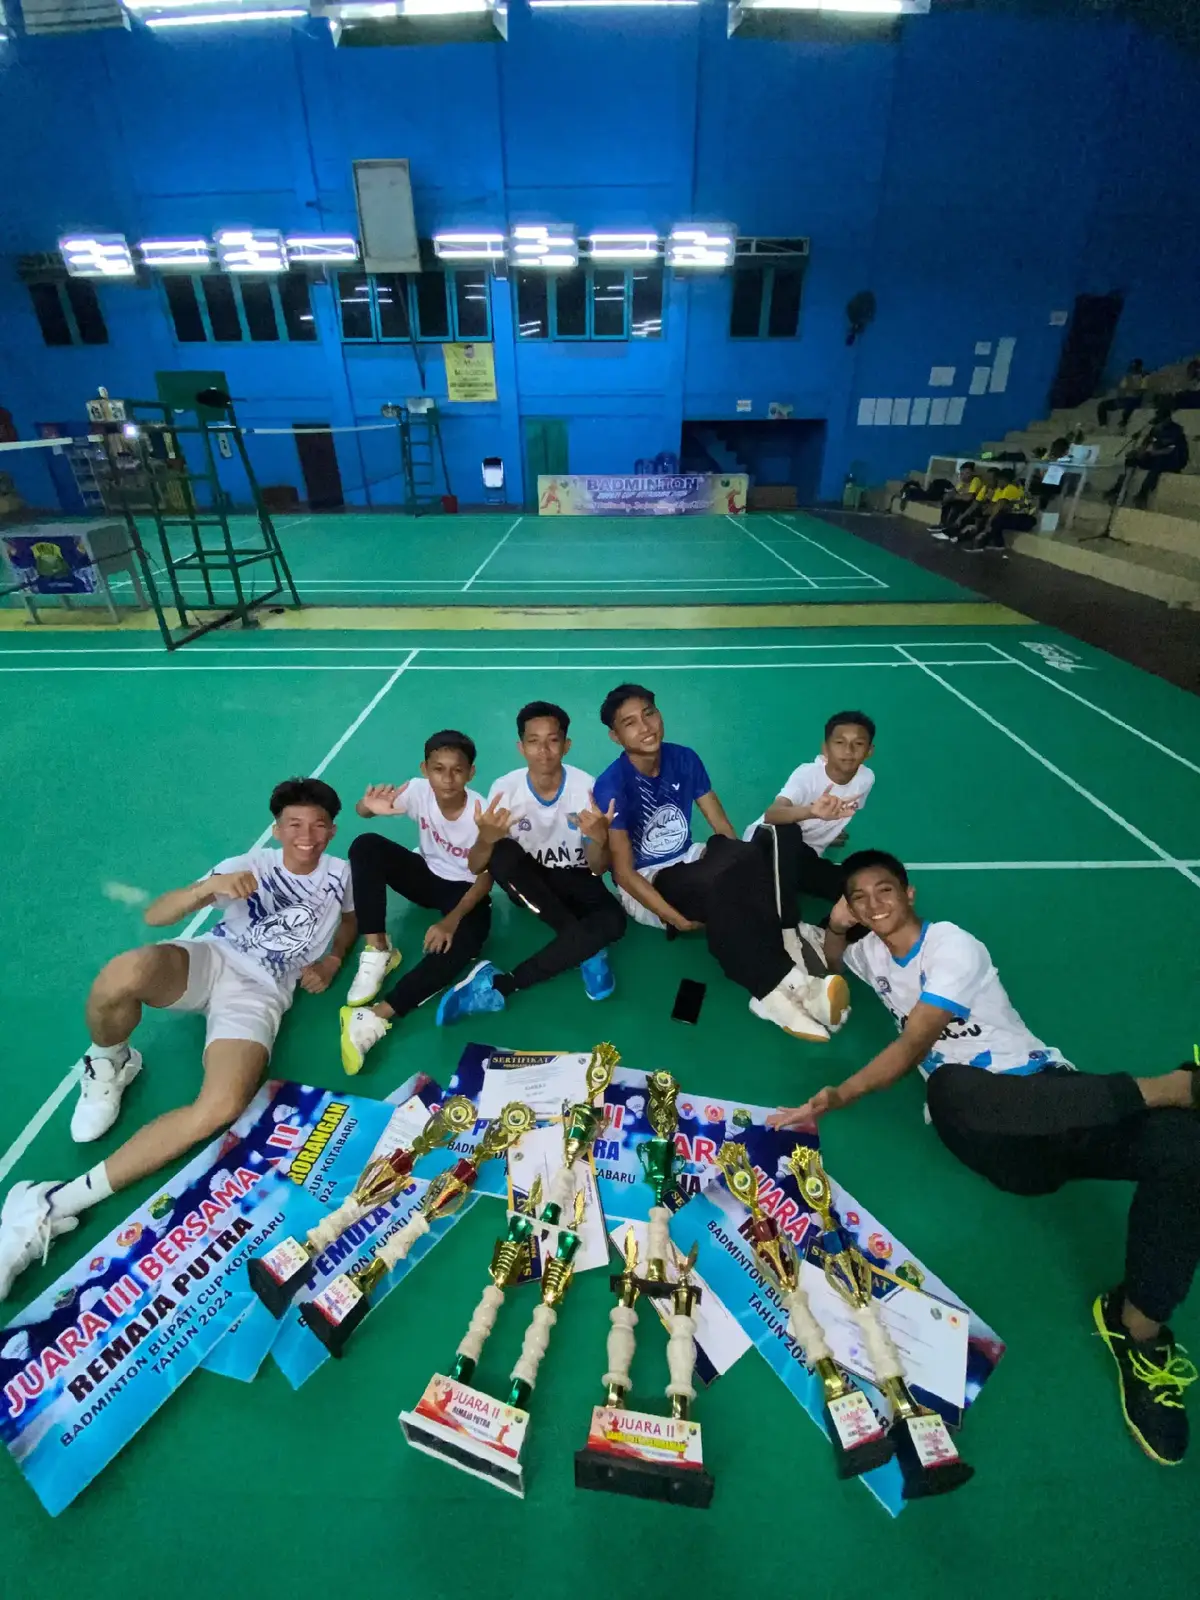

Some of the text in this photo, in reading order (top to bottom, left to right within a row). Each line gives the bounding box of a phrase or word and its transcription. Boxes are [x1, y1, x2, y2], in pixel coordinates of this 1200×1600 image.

[586, 478, 700, 492] BADMINTON
[491, 1055, 550, 1065] SERTIFIKAT
[320, 1118, 359, 1173] KOTABARU
[706, 1219, 767, 1289] BADMINTON
[4, 1166, 263, 1417] JUARA III BERSAMA
[66, 1215, 256, 1404] REMAJA PUTRA
[747, 1291, 787, 1340] TAHUN
[59, 1356, 149, 1448] BADMINTON
[147, 1304, 197, 1355] BUPATI
[196, 1274, 224, 1306] CUP
[224, 1211, 287, 1277] KOTABARU
[151, 1288, 234, 1376] TAHUN 2024
[453, 1390, 490, 1415] JUARA
[620, 1416, 675, 1438] JUARA II
